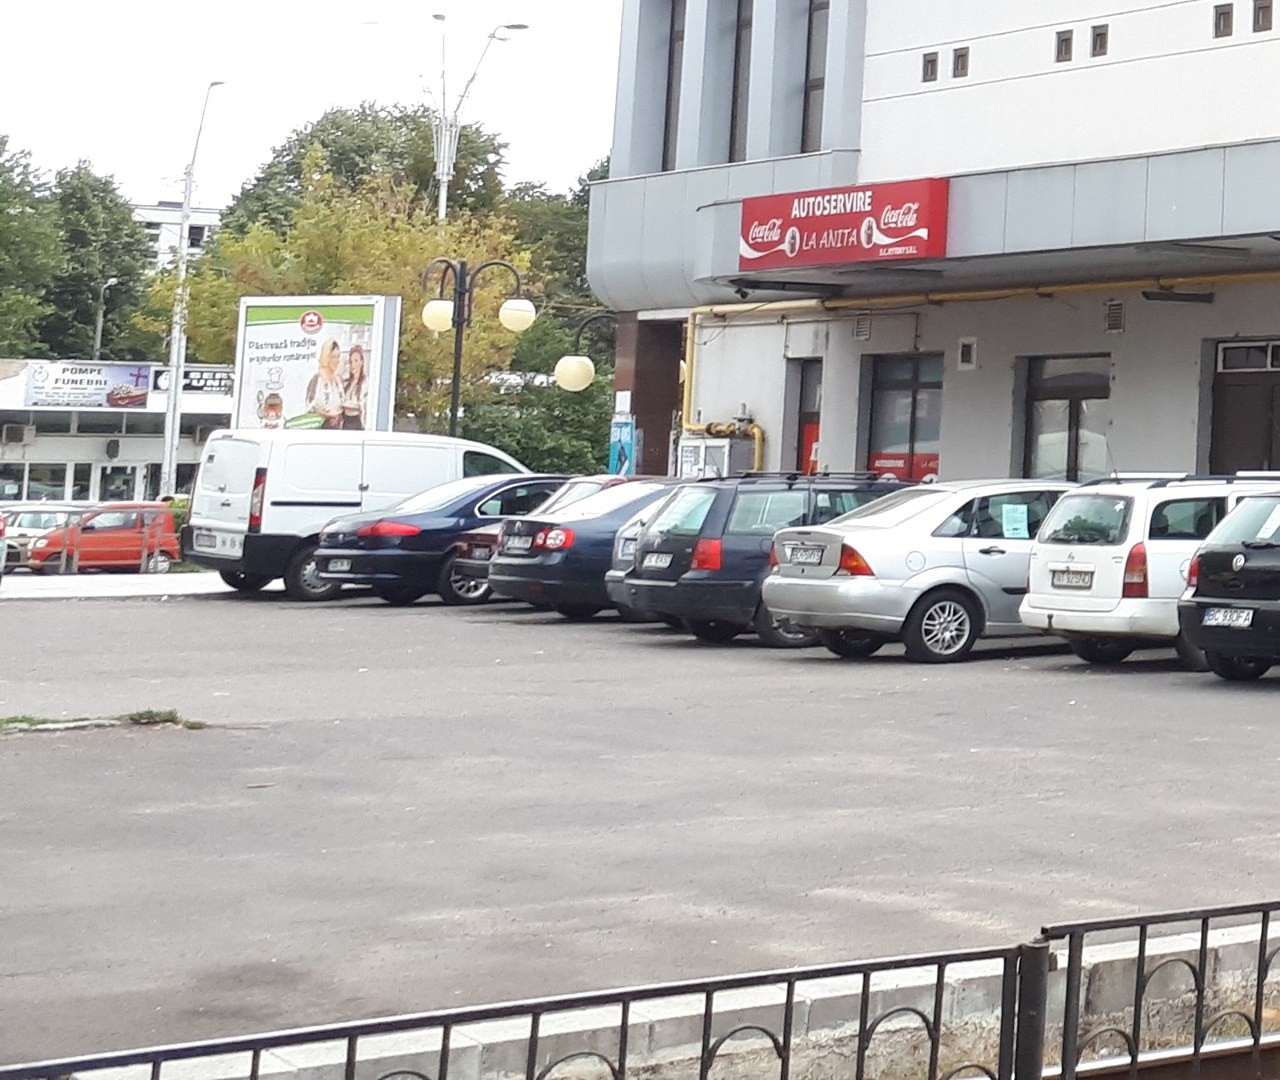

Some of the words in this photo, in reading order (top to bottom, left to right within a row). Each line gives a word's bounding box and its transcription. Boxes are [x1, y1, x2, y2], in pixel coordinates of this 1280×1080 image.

[790, 191, 873, 219] AUTOSERVIRE
[802, 231, 817, 250] LA
[819, 228, 858, 248] ANITA
[62, 367, 103, 375] POMPE
[1208, 609, 1221, 621] BC
